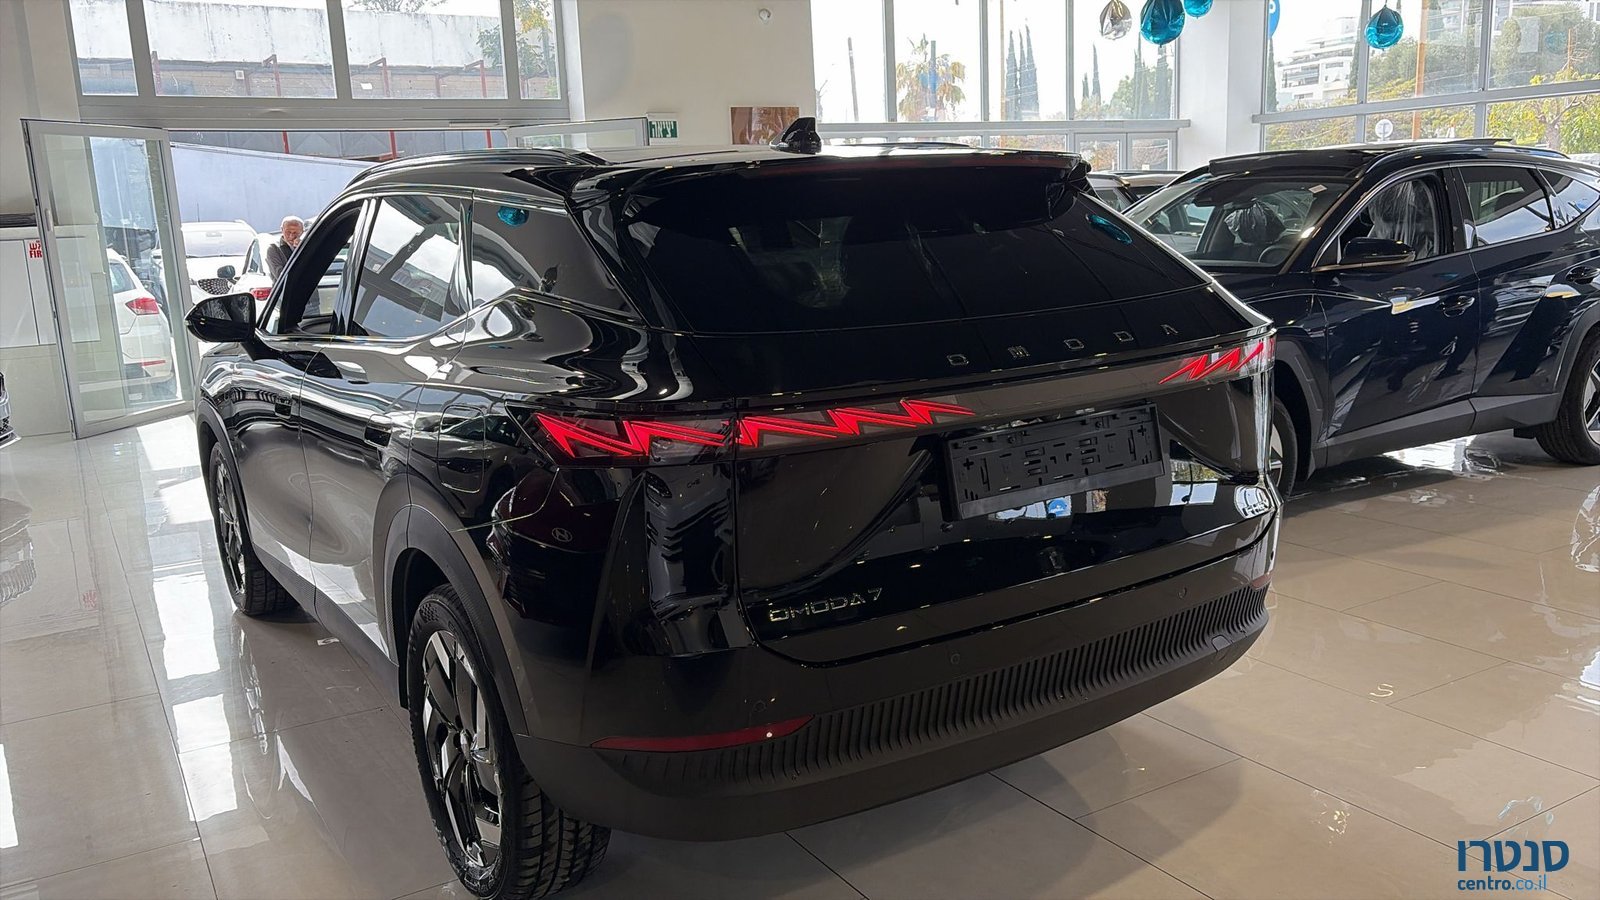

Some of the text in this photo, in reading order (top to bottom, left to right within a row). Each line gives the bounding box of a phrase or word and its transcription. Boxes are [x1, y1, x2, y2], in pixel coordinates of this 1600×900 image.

[651, 121, 674, 138] יציאה
[29, 250, 42, 258] FIR
[768, 586, 883, 622] OMODA 7
